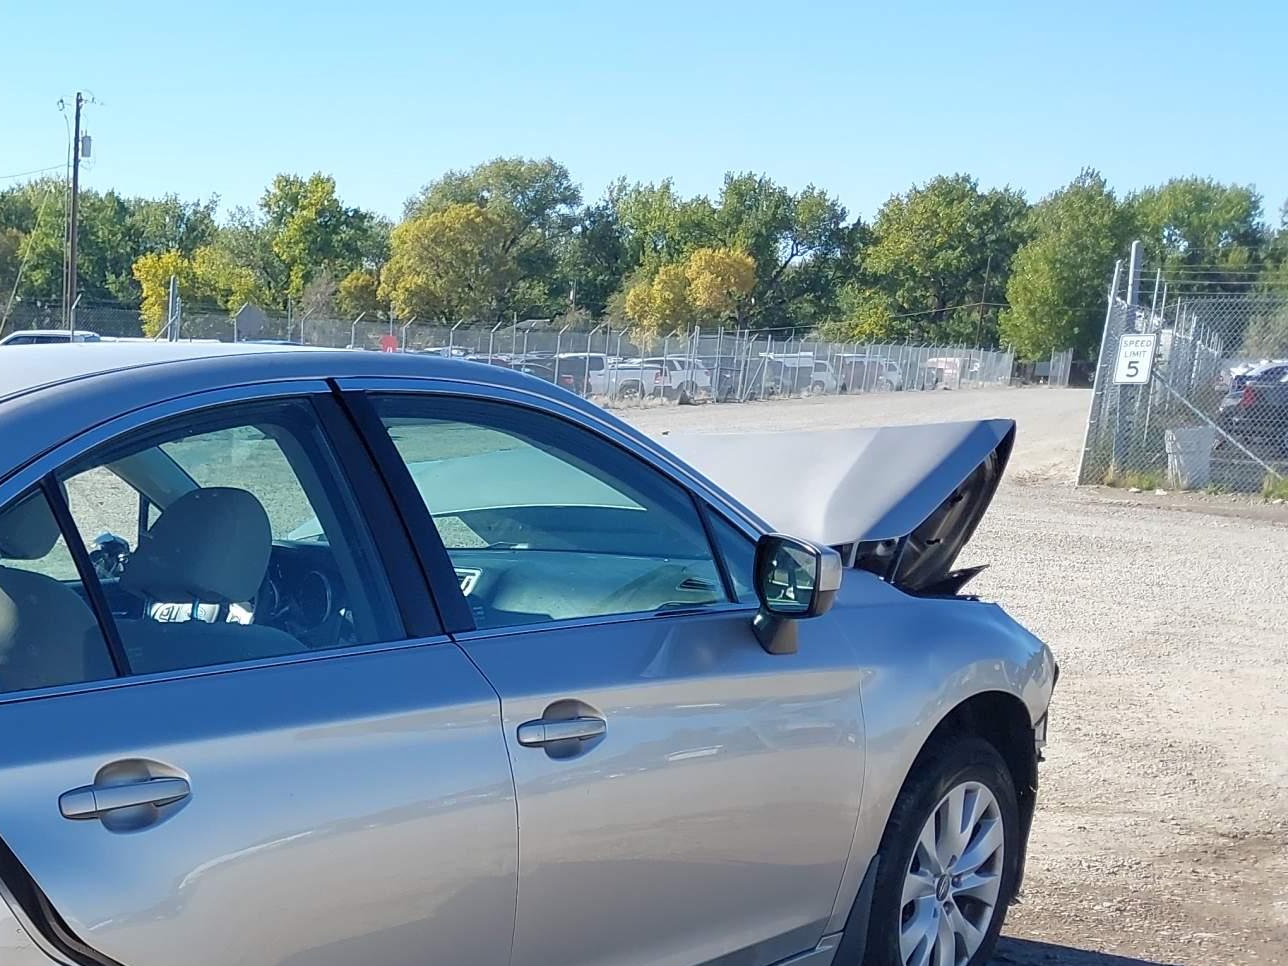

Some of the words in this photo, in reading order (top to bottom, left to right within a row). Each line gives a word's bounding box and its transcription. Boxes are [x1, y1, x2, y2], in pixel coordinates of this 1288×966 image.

[1123, 339, 1152, 348] SPEED
[1124, 350, 1147, 358] LIMIT
[1125, 360, 1140, 378] 5
